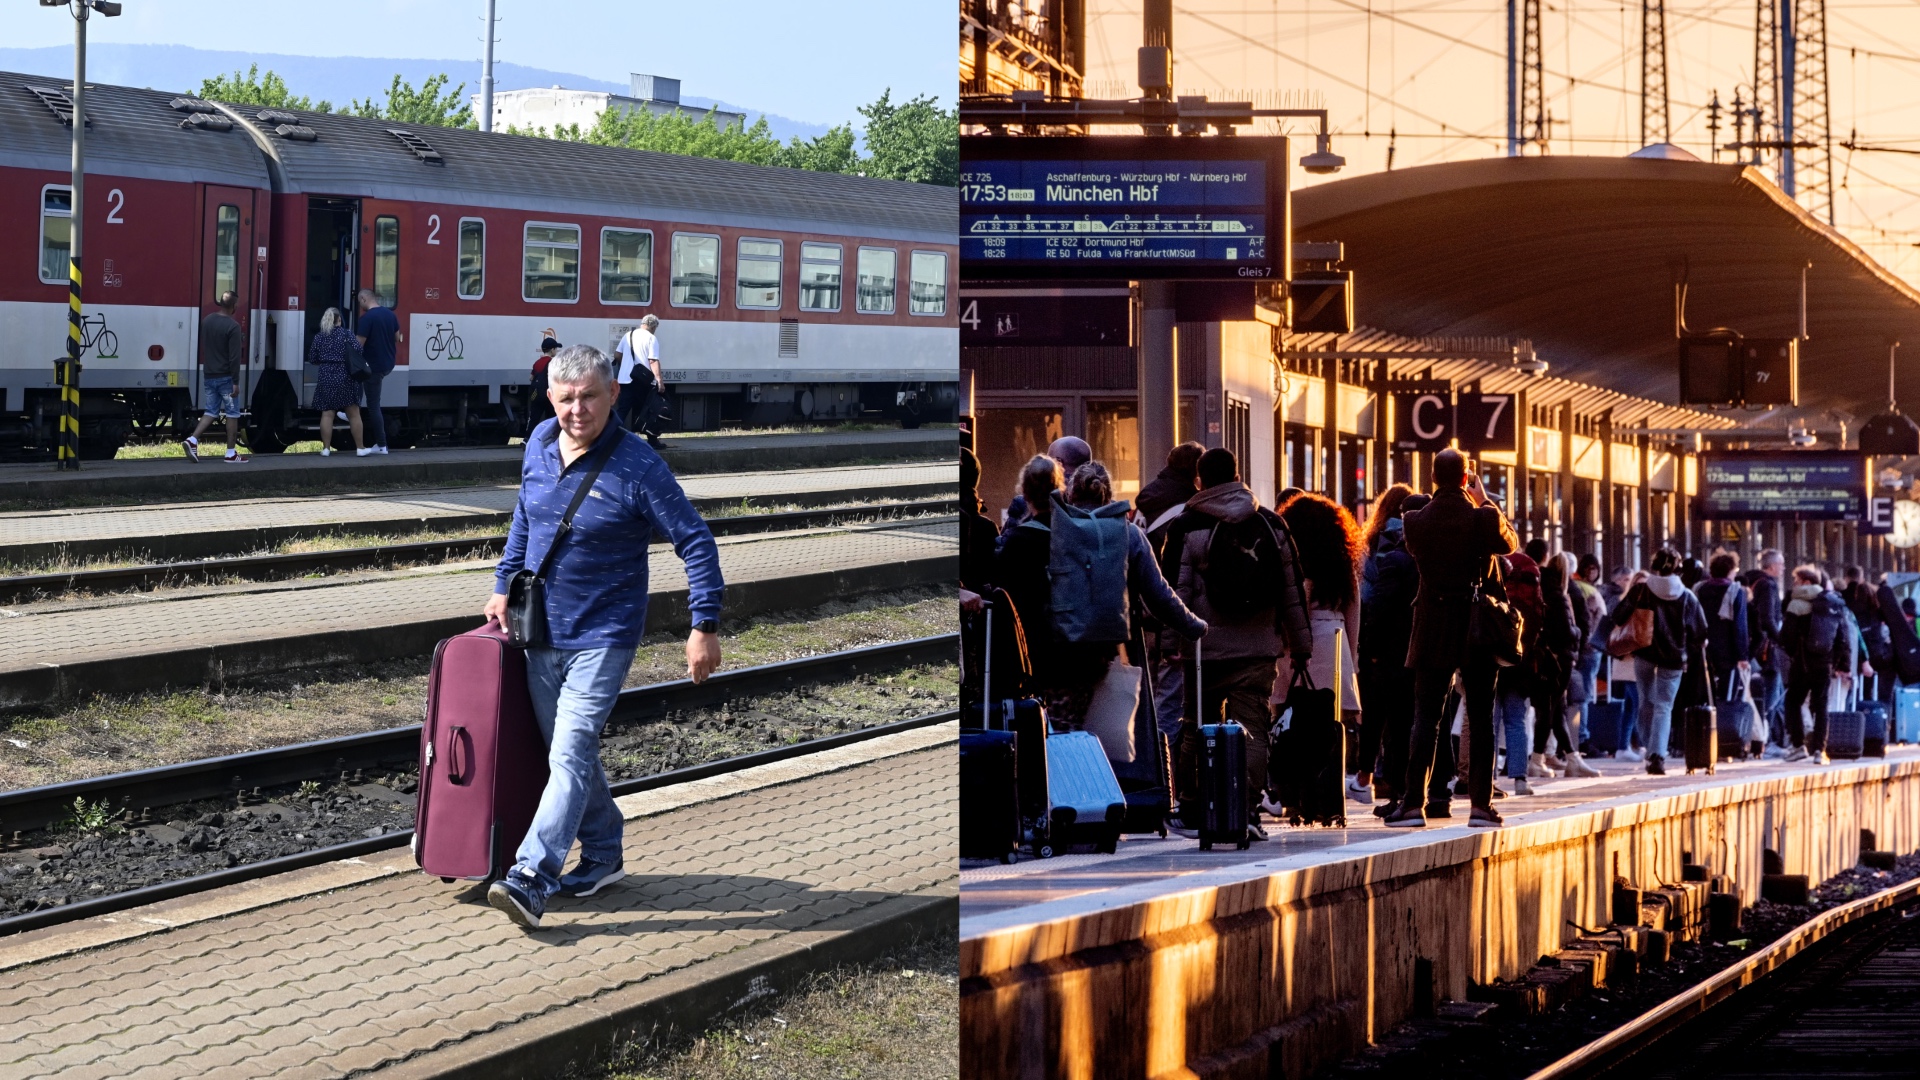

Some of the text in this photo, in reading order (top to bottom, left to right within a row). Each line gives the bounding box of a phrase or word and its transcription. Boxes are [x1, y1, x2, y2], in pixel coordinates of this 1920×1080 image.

[960, 173, 992, 182] ICE 725
[1046, 173, 1111, 183] Aschaffenburg
[1120, 173, 1163, 183] Würzburg
[1165, 173, 1180, 182] Hbf
[1190, 173, 1230, 183] Nürnberg
[1232, 173, 1247, 182] Hbf
[960, 185, 1006, 201] 17:53
[1046, 184, 1123, 201] München
[1130, 185, 1159, 201] Hbf
[106, 189, 124, 224] 2
[427, 214, 441, 245] 2
[983, 238, 1264, 246] 18:09 ICE 622 Dortmund Hbf A-F
[983, 250, 1264, 258] 18:26 RE 50 Fulda via Frankfurt(M)Süd A-C
[1238, 267, 1272, 277] Gleis 7
[960, 299, 982, 331] 4
[1412, 394, 1509, 440] C 7
[1872, 497, 1892, 528] E
